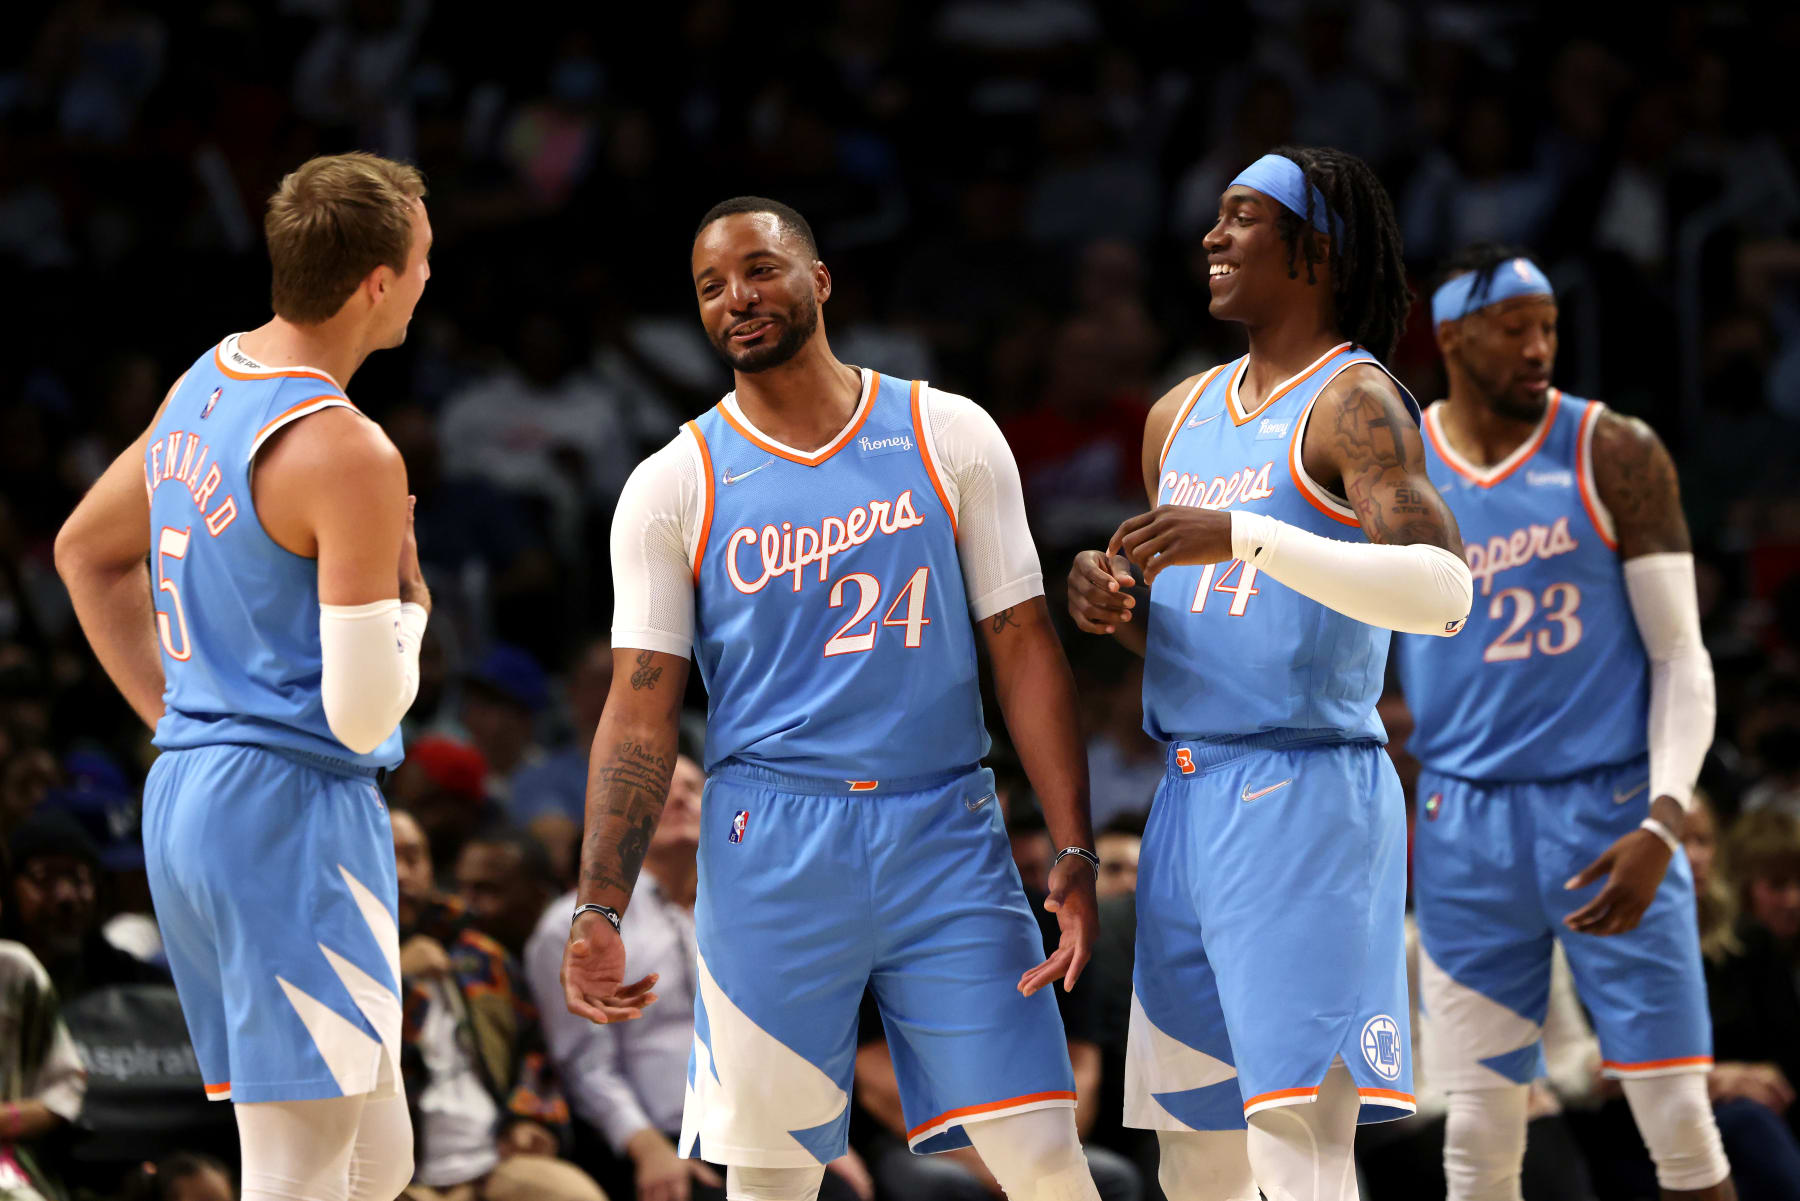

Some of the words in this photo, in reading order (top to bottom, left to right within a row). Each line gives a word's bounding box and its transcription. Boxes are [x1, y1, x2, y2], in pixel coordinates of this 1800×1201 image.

[858, 435, 913, 452] honey
[1259, 418, 1288, 438] honey
[144, 431, 238, 536] ENNARD
[726, 490, 925, 594] Clippers
[1464, 516, 1579, 597] ppers
[156, 525, 191, 662] 5
[824, 566, 931, 658] 24
[1190, 558, 1260, 617] 14
[1483, 582, 1583, 663] 23
